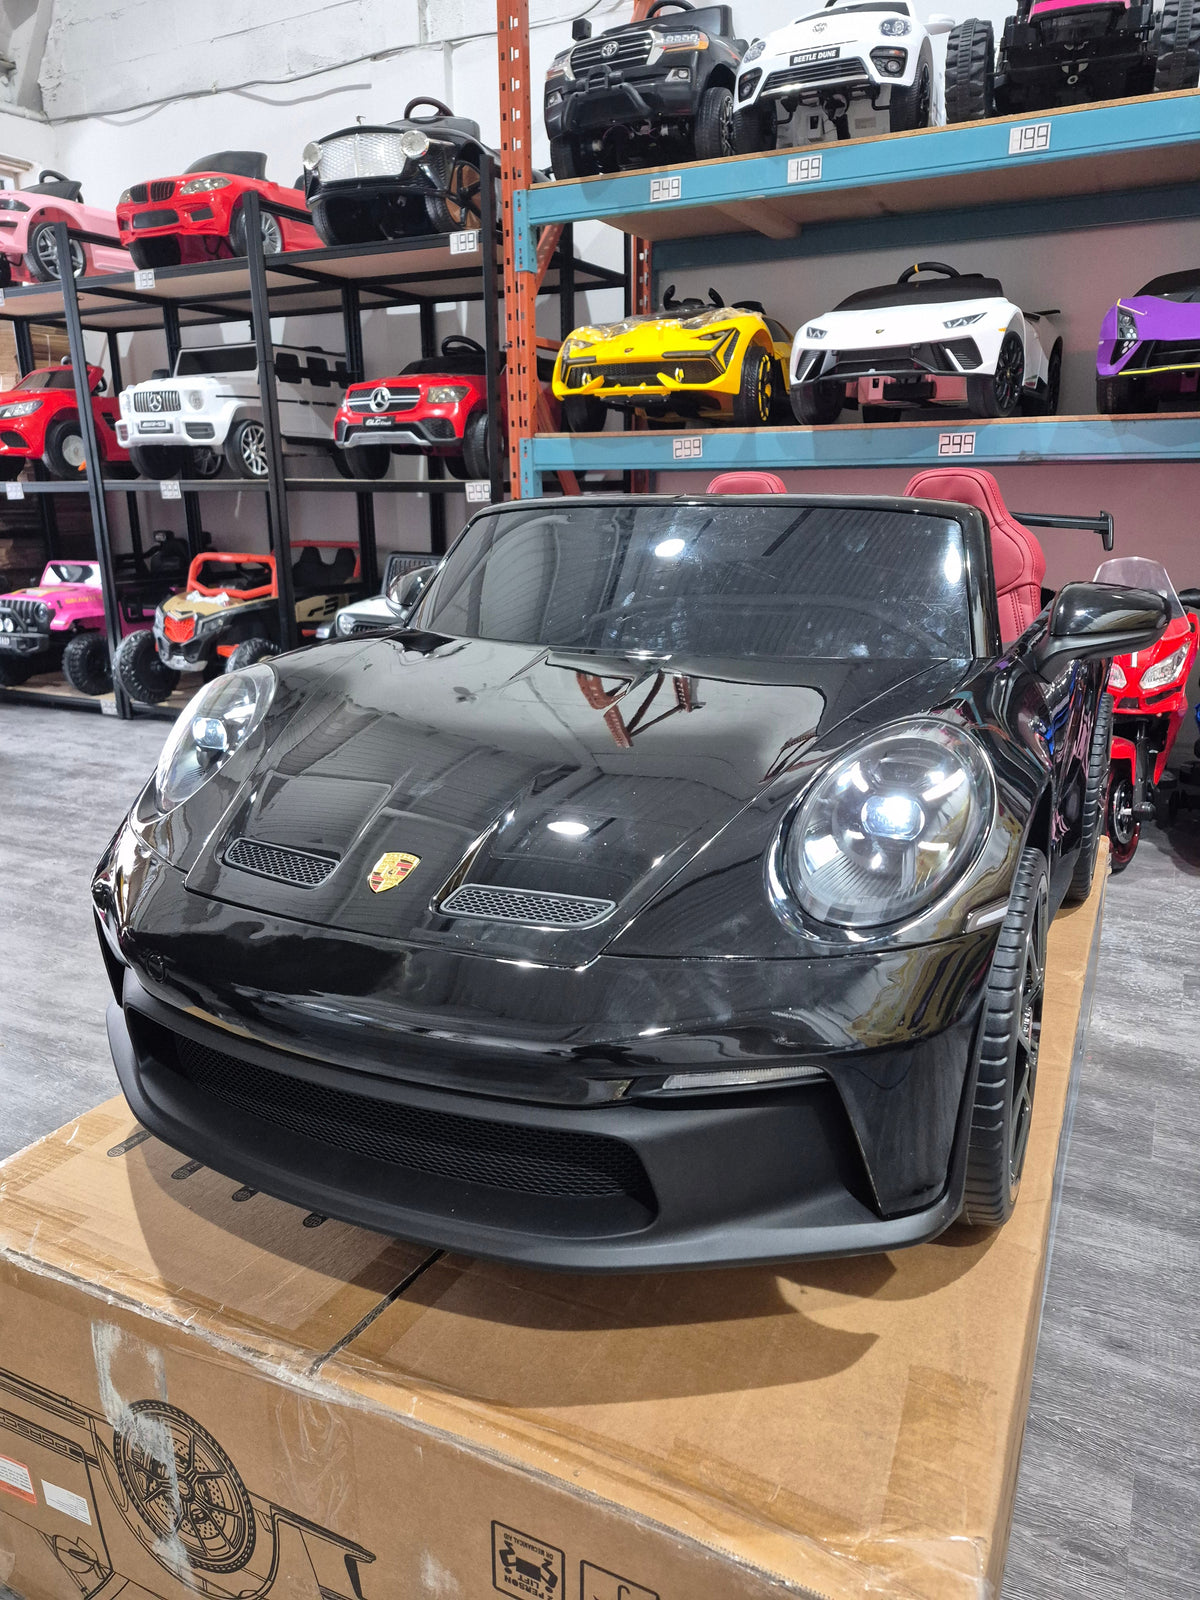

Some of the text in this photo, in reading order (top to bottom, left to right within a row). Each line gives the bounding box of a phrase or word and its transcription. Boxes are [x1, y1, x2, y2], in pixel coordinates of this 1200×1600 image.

[793, 49, 837, 64] BEETLE DUNE
[1019, 123, 1050, 151] 199
[796, 157, 821, 181] 199
[652, 177, 680, 200] 249
[675, 438, 702, 458] 299
[940, 434, 974, 454] 299
[467, 483, 490, 501] 299
[513, 1536, 545, 1557] MECHANICAL
[504, 1574, 545, 1600] PERSON
[517, 1574, 540, 1590] LIFT
